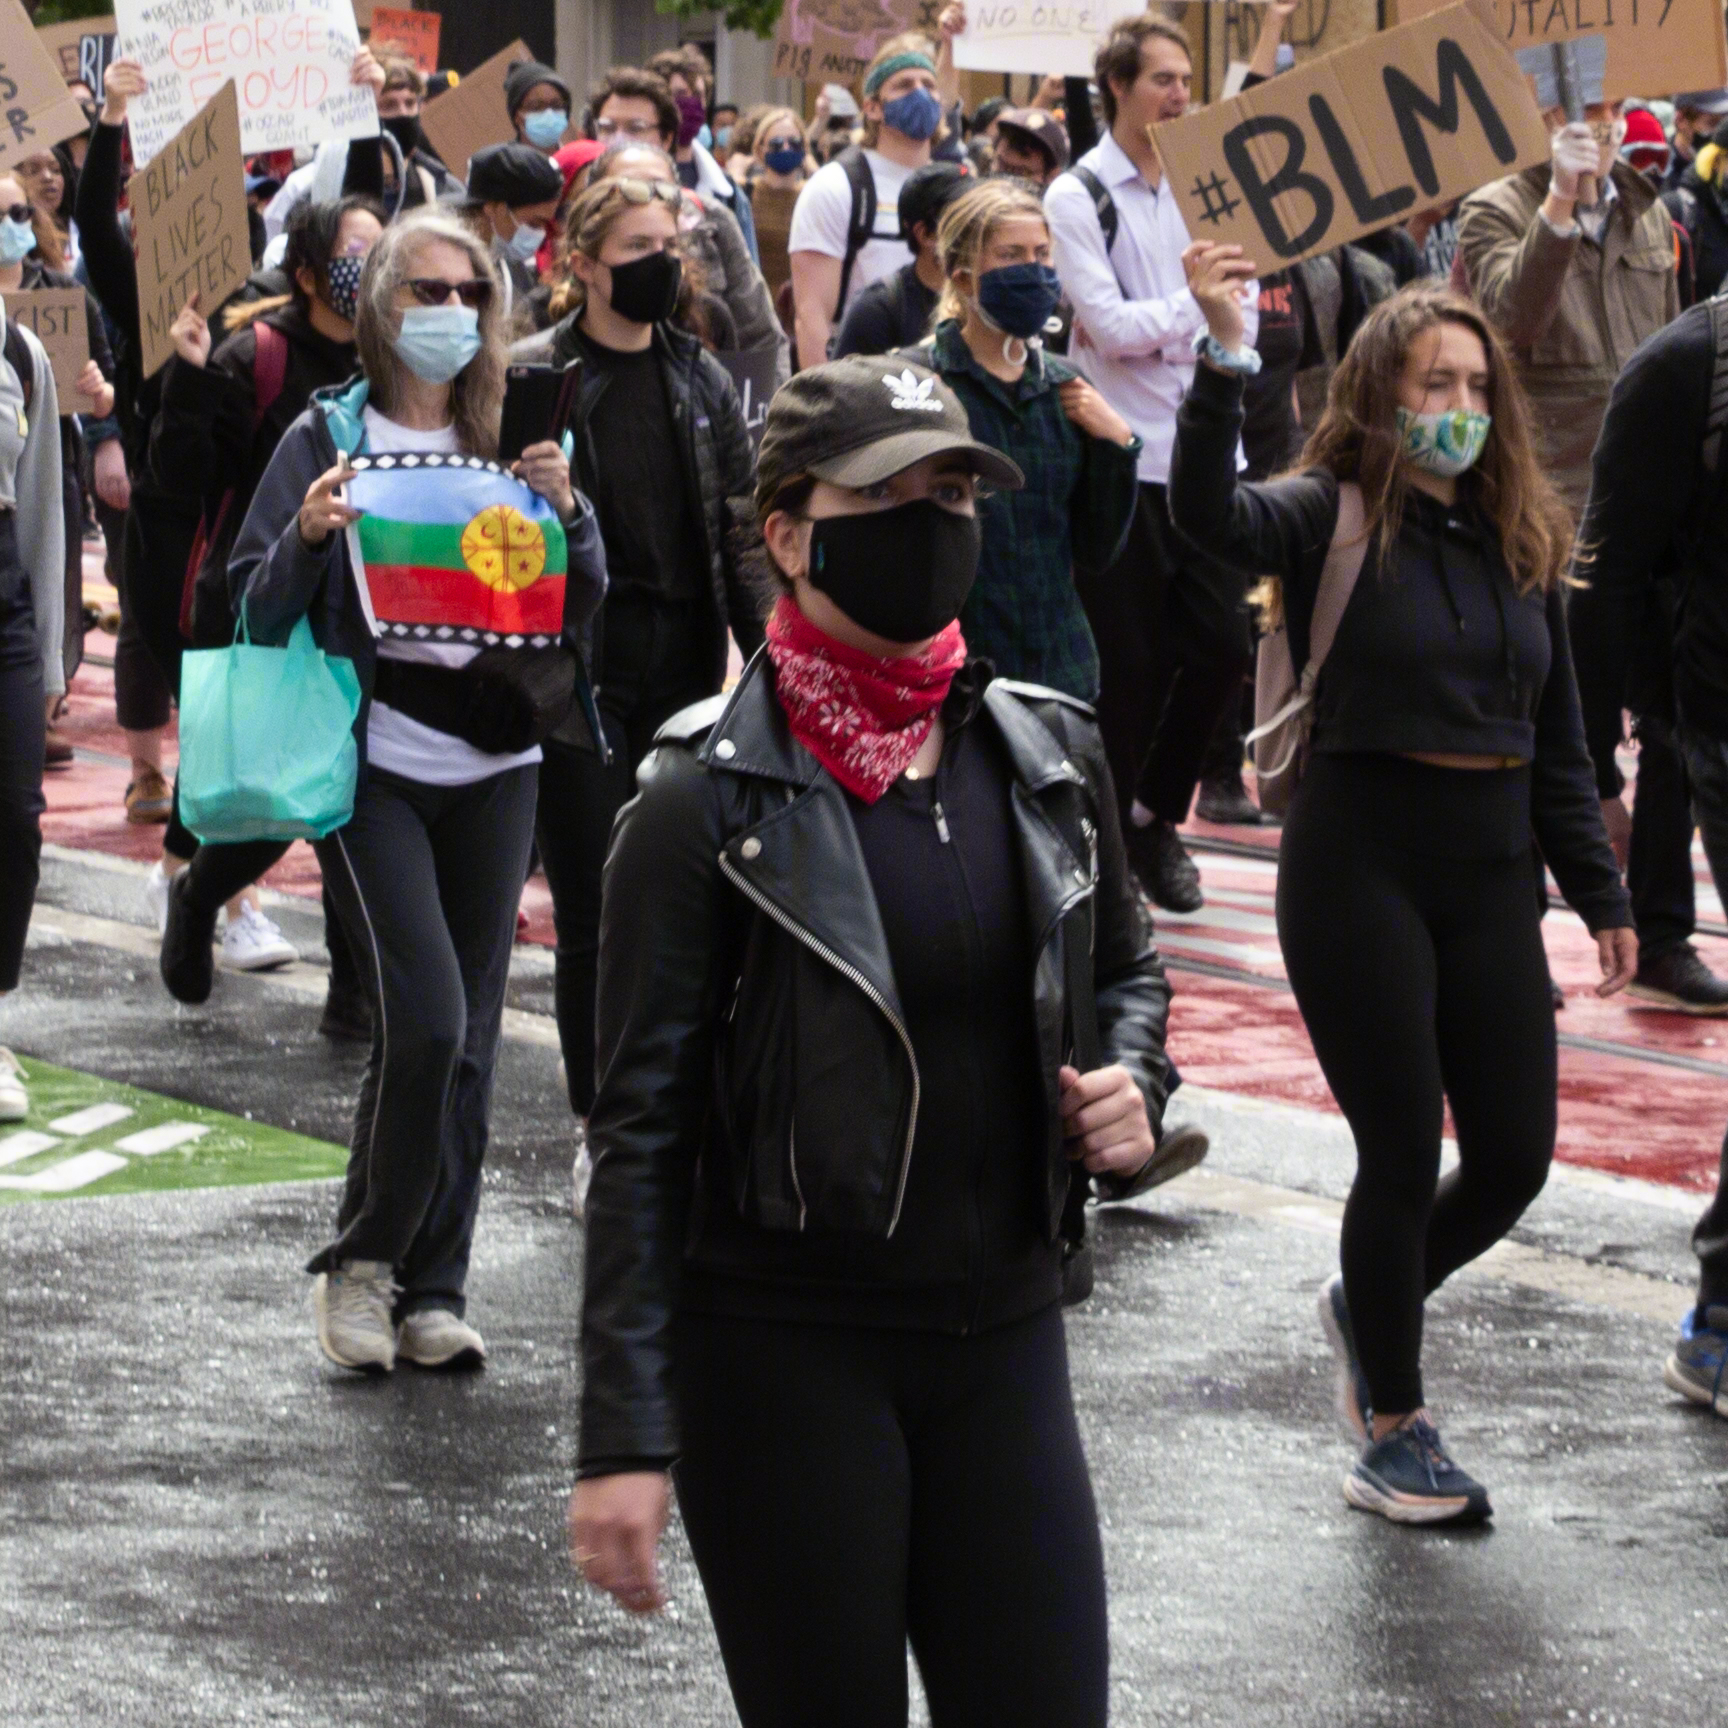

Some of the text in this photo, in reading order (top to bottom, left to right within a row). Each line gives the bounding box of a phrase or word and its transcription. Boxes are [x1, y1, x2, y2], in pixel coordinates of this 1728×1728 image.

[170, 13, 327, 71] GEORGE
[977, 4, 1099, 33] NO ONE
[189, 64, 329, 115] FOYD
[146, 109, 220, 217] BLACK
[1190, 38, 1517, 259] #BLM
[153, 175, 223, 286] LIVES
[146, 233, 238, 355] MATTER
